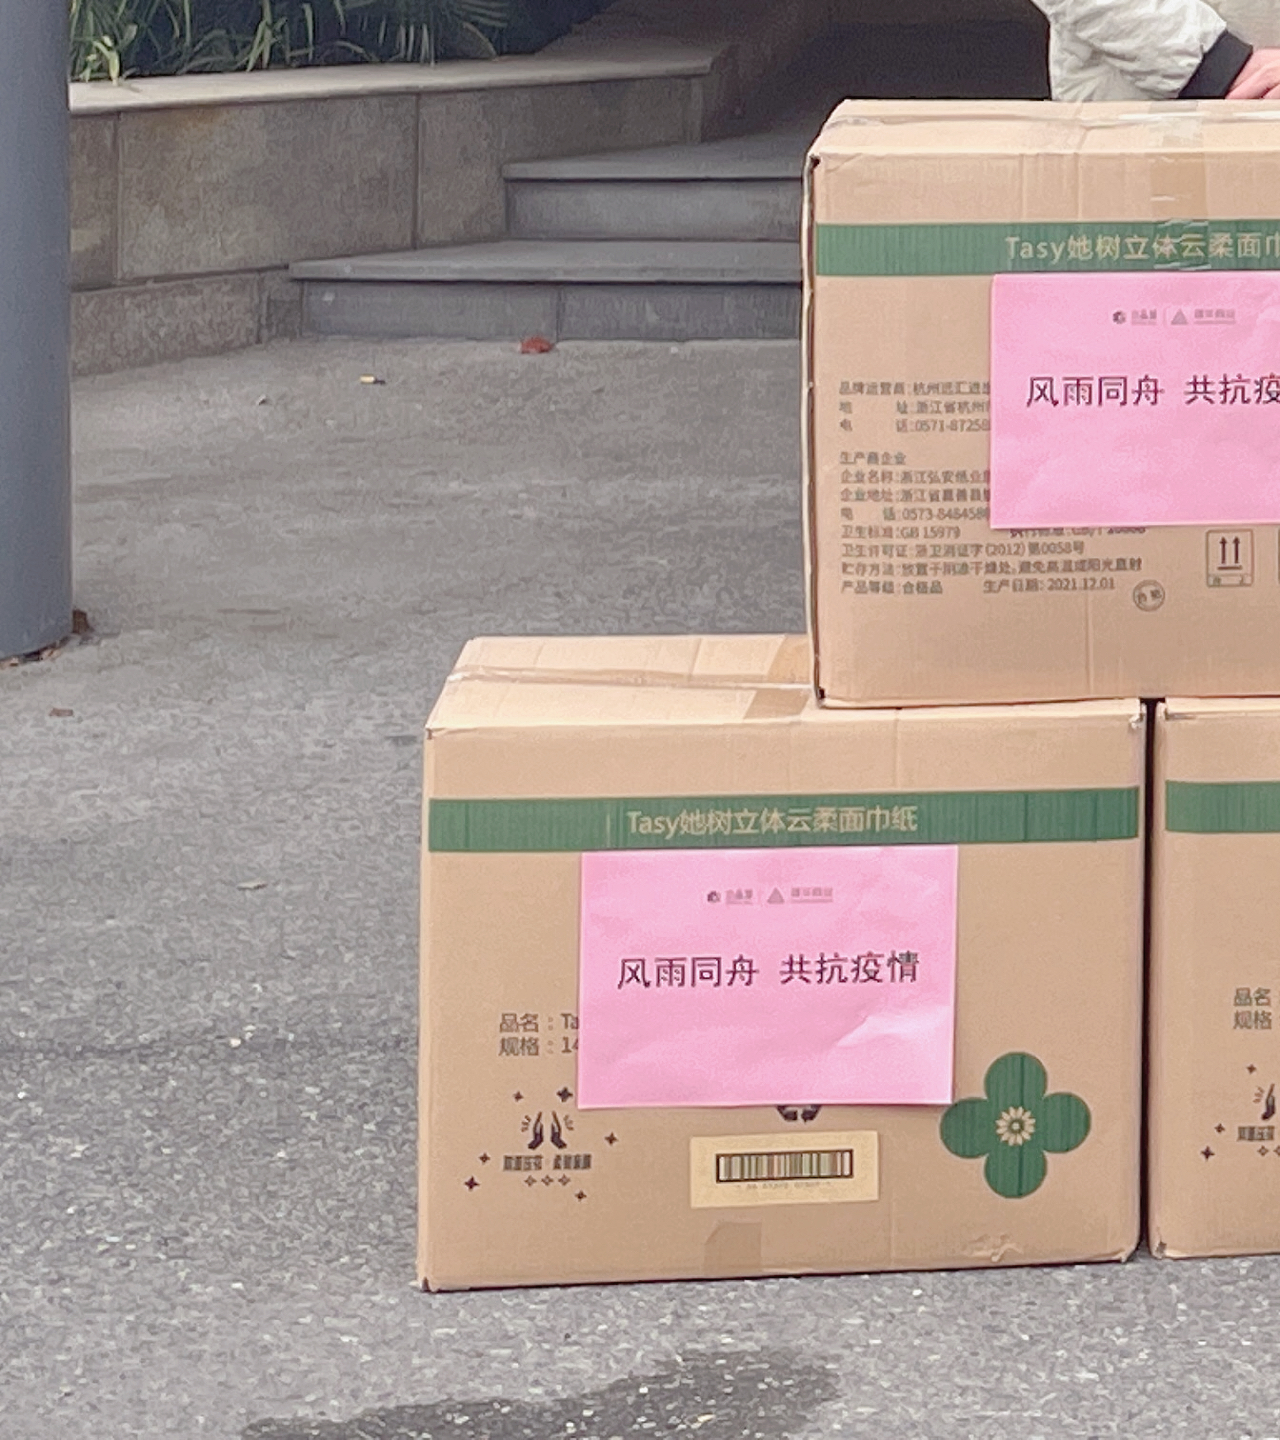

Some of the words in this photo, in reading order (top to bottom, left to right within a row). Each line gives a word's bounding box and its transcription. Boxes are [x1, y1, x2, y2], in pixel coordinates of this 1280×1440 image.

[1027, 375, 1165, 407] 风雨同舟
[628, 806, 917, 836] Tasy她树立体云柔面巾纸
[618, 955, 759, 988] 风雨同舟
[780, 951, 919, 986] 共抗疫情
